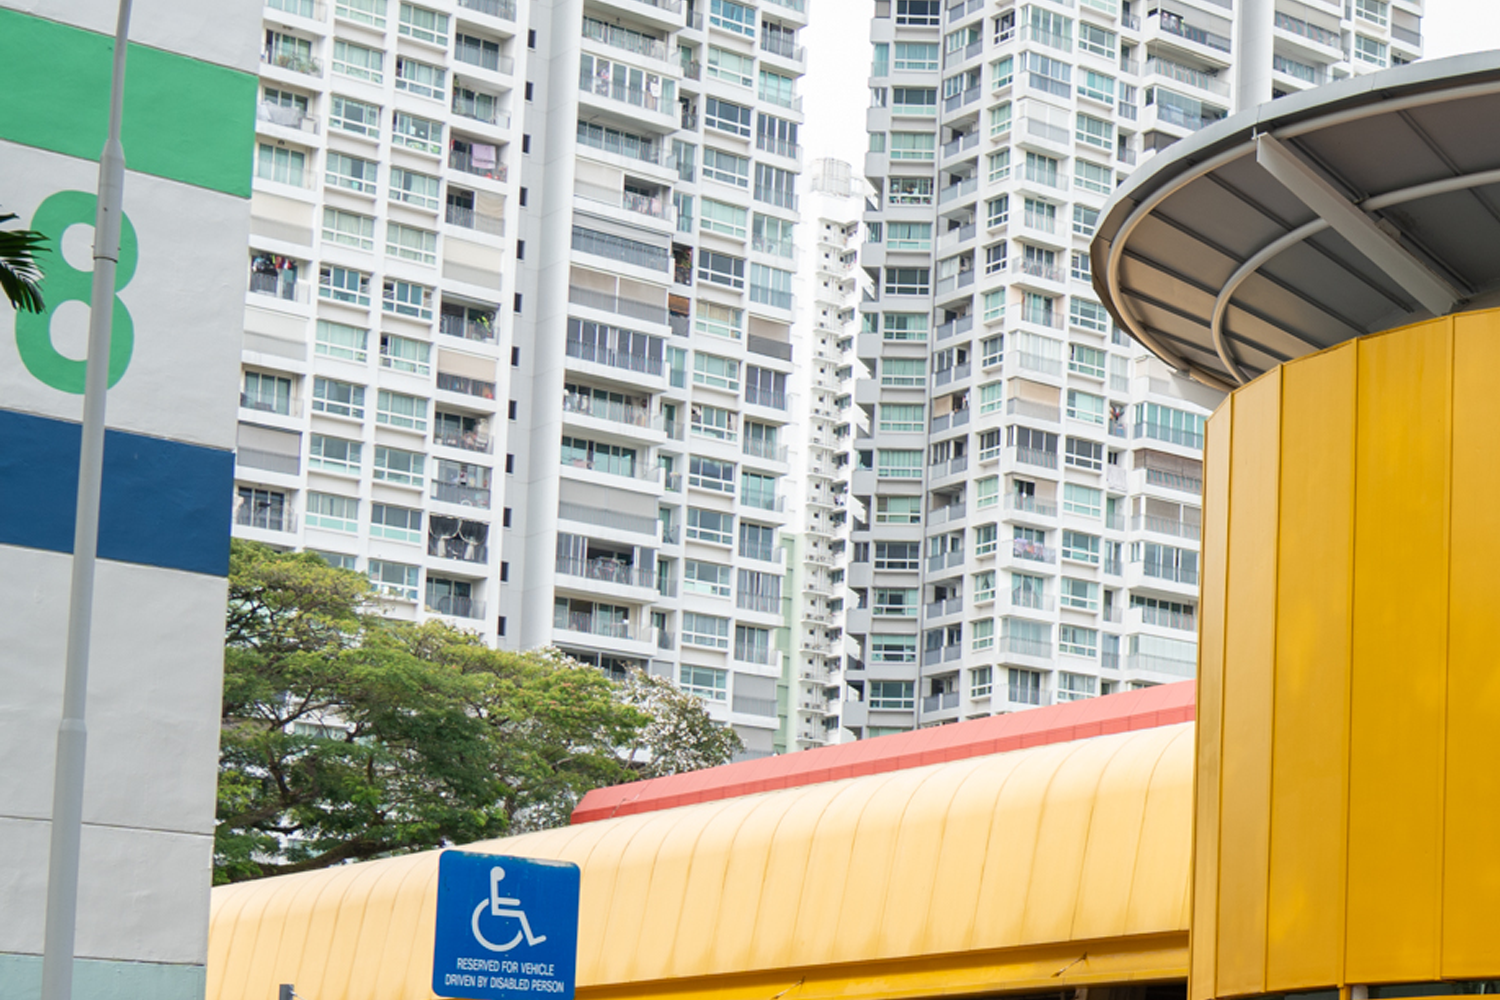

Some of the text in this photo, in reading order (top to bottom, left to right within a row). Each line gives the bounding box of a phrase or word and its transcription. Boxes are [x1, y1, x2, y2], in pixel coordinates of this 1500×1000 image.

[15, 190, 138, 394] 8
[457, 957, 555, 977] RESERVED FOR VEHICLE
[444, 973, 565, 993] DRIVEN BY DISABLED PERSON
